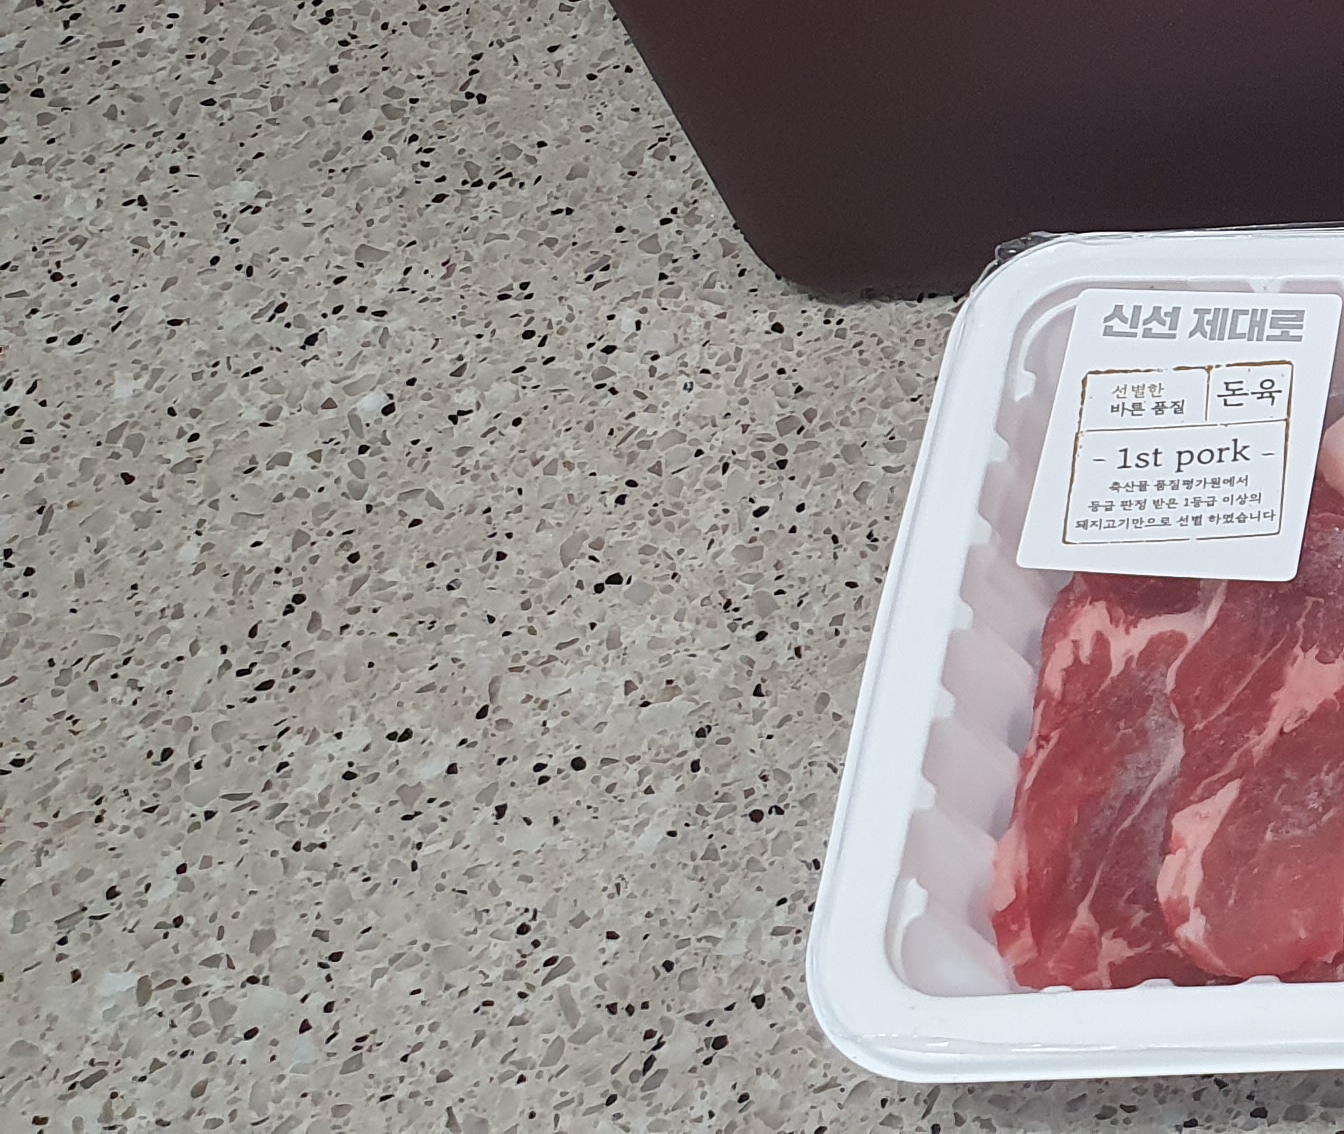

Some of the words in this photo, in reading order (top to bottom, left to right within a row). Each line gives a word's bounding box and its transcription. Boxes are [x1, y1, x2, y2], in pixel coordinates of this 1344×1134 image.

[1102, 304, 1182, 340] 신선
[1188, 307, 1306, 343] 제대로
[1112, 382, 1165, 400] 선별한
[1217, 378, 1283, 408] 돈육
[1110, 401, 1146, 417] 바른
[1151, 399, 1185, 416] 품질
[1117, 447, 1163, 470] 1st
[1175, 437, 1251, 473] pork
[1109, 480, 1151, 493] 축산물
[1088, 500, 1117, 513] 등급
[1120, 498, 1148, 512] 판정
[1153, 498, 1179, 510] 받은
[1183, 495, 1218, 510] 1등급
[1222, 492, 1262, 506] 이상의
[1075, 517, 1172, 531] 돼지고기만으로
[1209, 509, 1276, 525] 하였습니다
